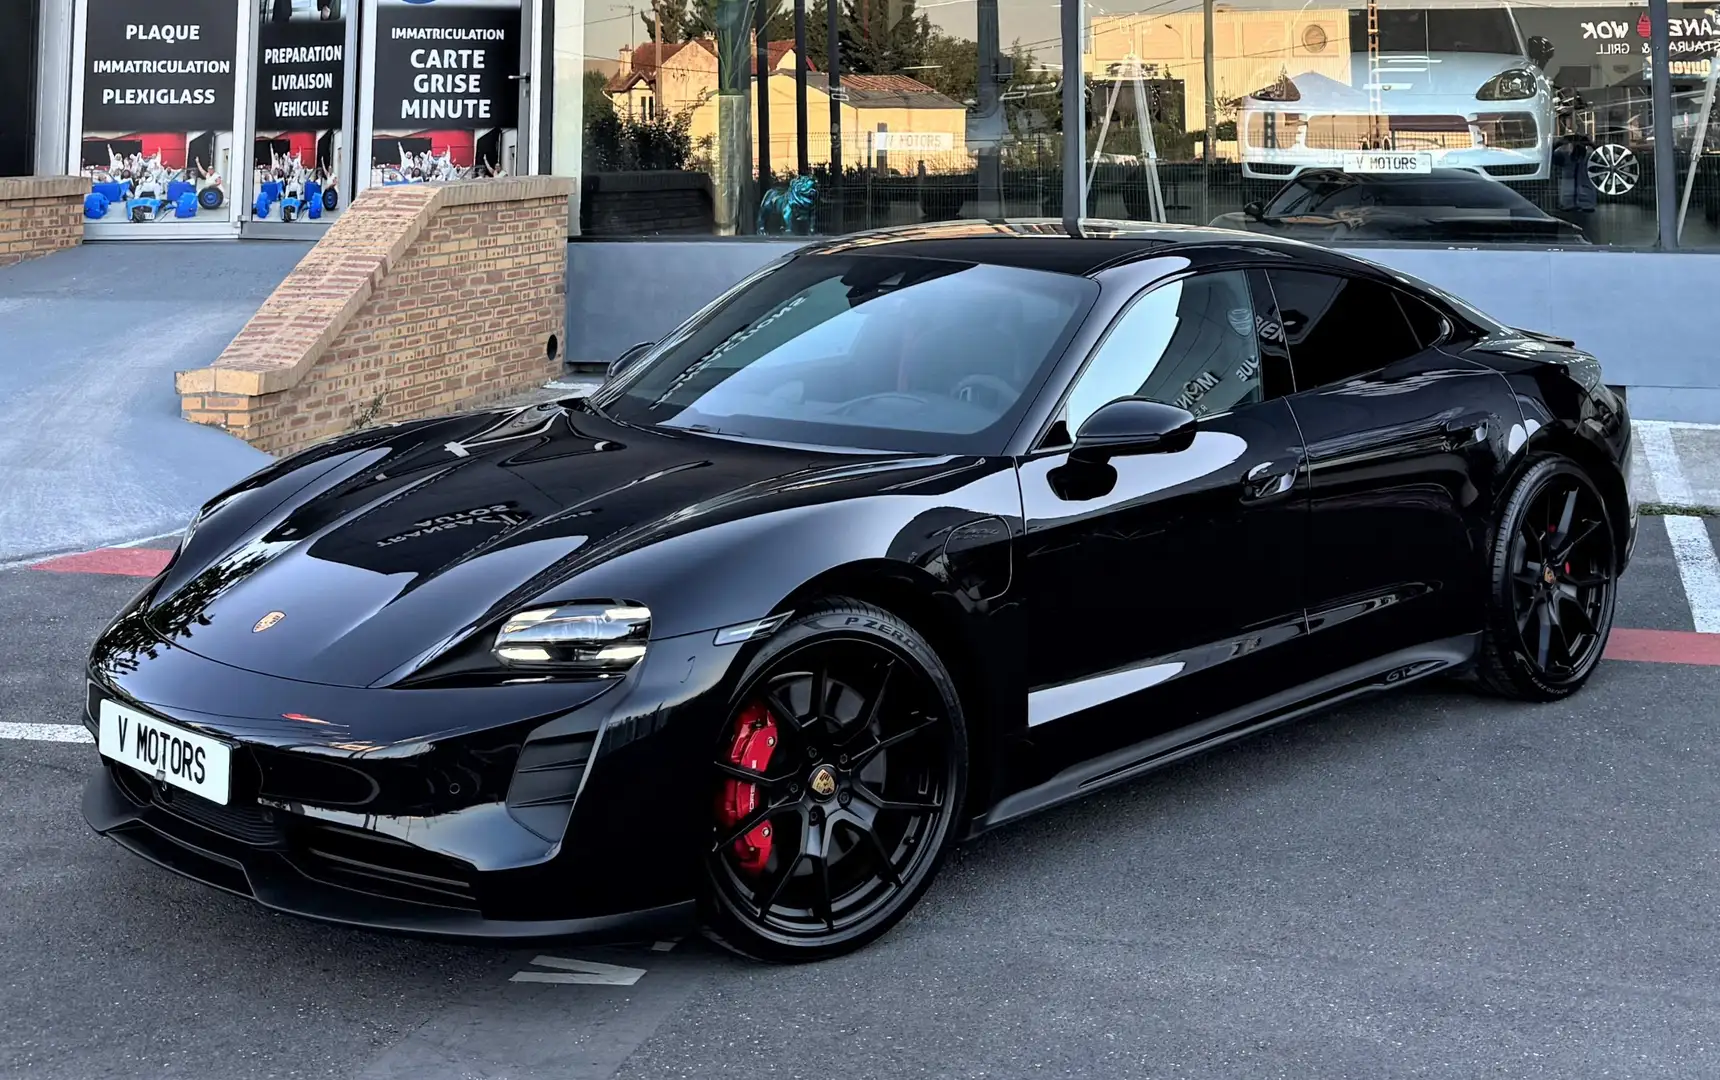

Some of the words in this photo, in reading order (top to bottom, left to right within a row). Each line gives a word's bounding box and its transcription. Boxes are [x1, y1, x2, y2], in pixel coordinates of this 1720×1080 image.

[125, 24, 200, 44] PLAQUE
[391, 27, 505, 41] IMMATRICULATION
[264, 45, 342, 64] PREPARATION
[410, 49, 486, 69] CARTE
[93, 60, 230, 74] IMMATRICULATION
[271, 72, 333, 91] LIVRAISON
[413, 73, 481, 94] GRISE
[102, 88, 216, 105] PLEXIGLASS
[274, 100, 329, 117] VEHICULE
[401, 99, 491, 120] MINUTE
[1355, 156, 1364, 169] V
[1370, 156, 1417, 170] MOTORS
[844, 617, 859, 625] P
[863, 619, 918, 650] ZERO
[118, 714, 128, 753] V
[136, 722, 206, 785] MOTORS
